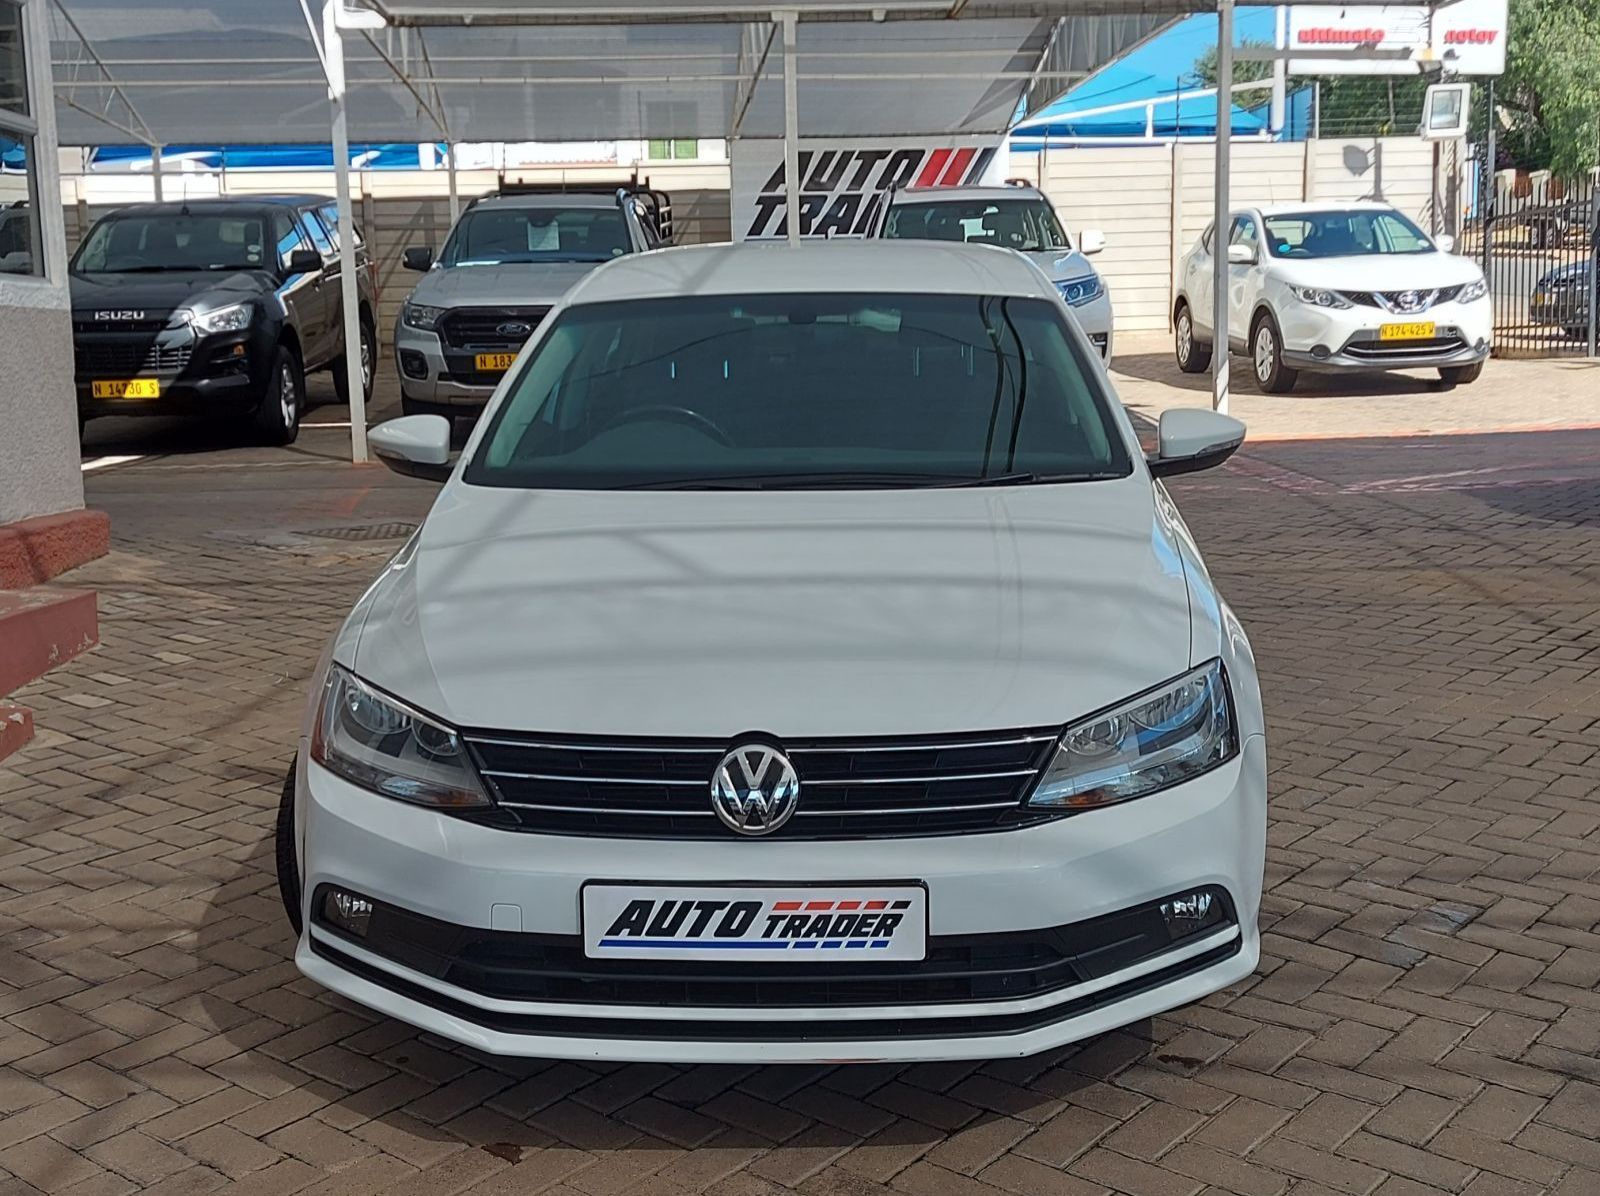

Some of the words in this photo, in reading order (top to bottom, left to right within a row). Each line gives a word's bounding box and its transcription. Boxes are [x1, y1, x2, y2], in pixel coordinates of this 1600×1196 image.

[760, 150, 926, 193] AUTO
[95, 311, 144, 320] ISUZU
[480, 356, 487, 368] N
[493, 355, 513, 367] 183
[95, 384, 102, 396] N
[109, 383, 142, 395] 14730
[149, 382, 156, 393] S
[604, 900, 764, 938] AUTO
[760, 914, 904, 938] TRADER
